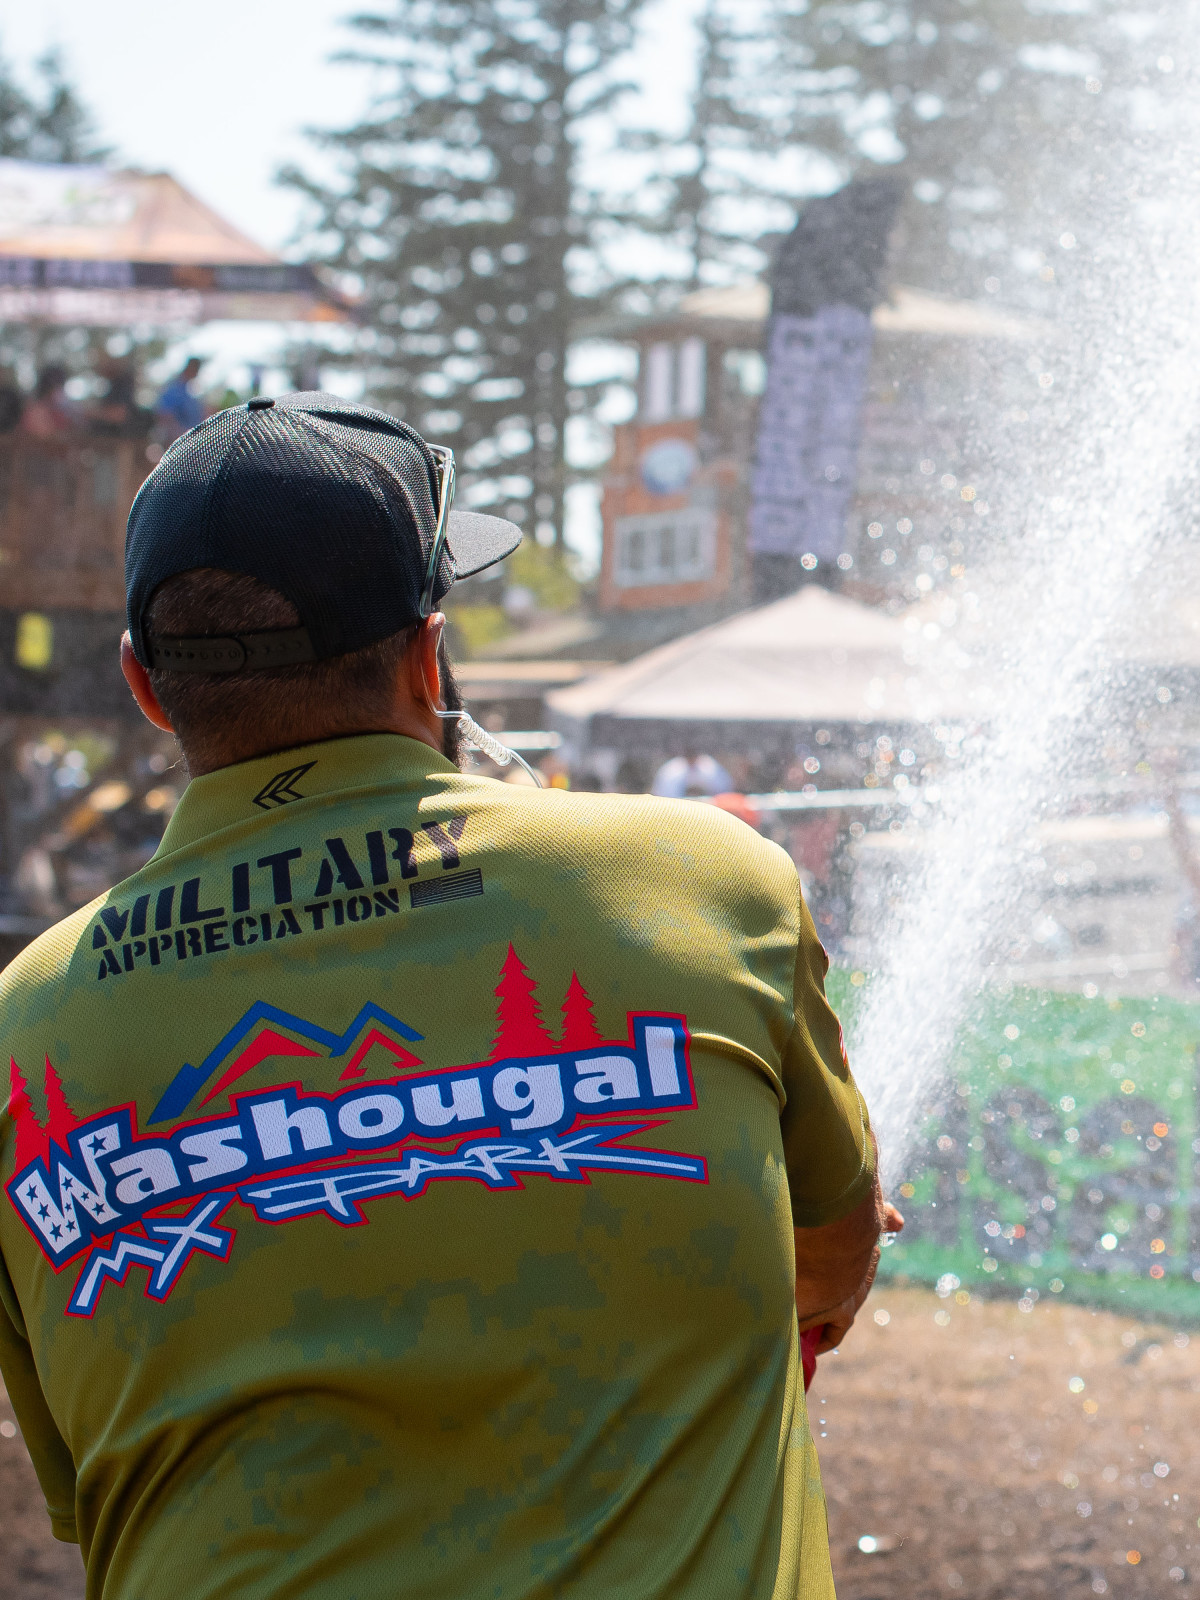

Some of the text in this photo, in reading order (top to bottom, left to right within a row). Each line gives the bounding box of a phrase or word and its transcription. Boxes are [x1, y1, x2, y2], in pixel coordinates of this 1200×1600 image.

[92, 816, 469, 949] MILITARY
[97, 888, 401, 980] APPRECIATION
[14, 1025, 682, 1255] Washougal
[75, 1133, 698, 1308] MX PARK
